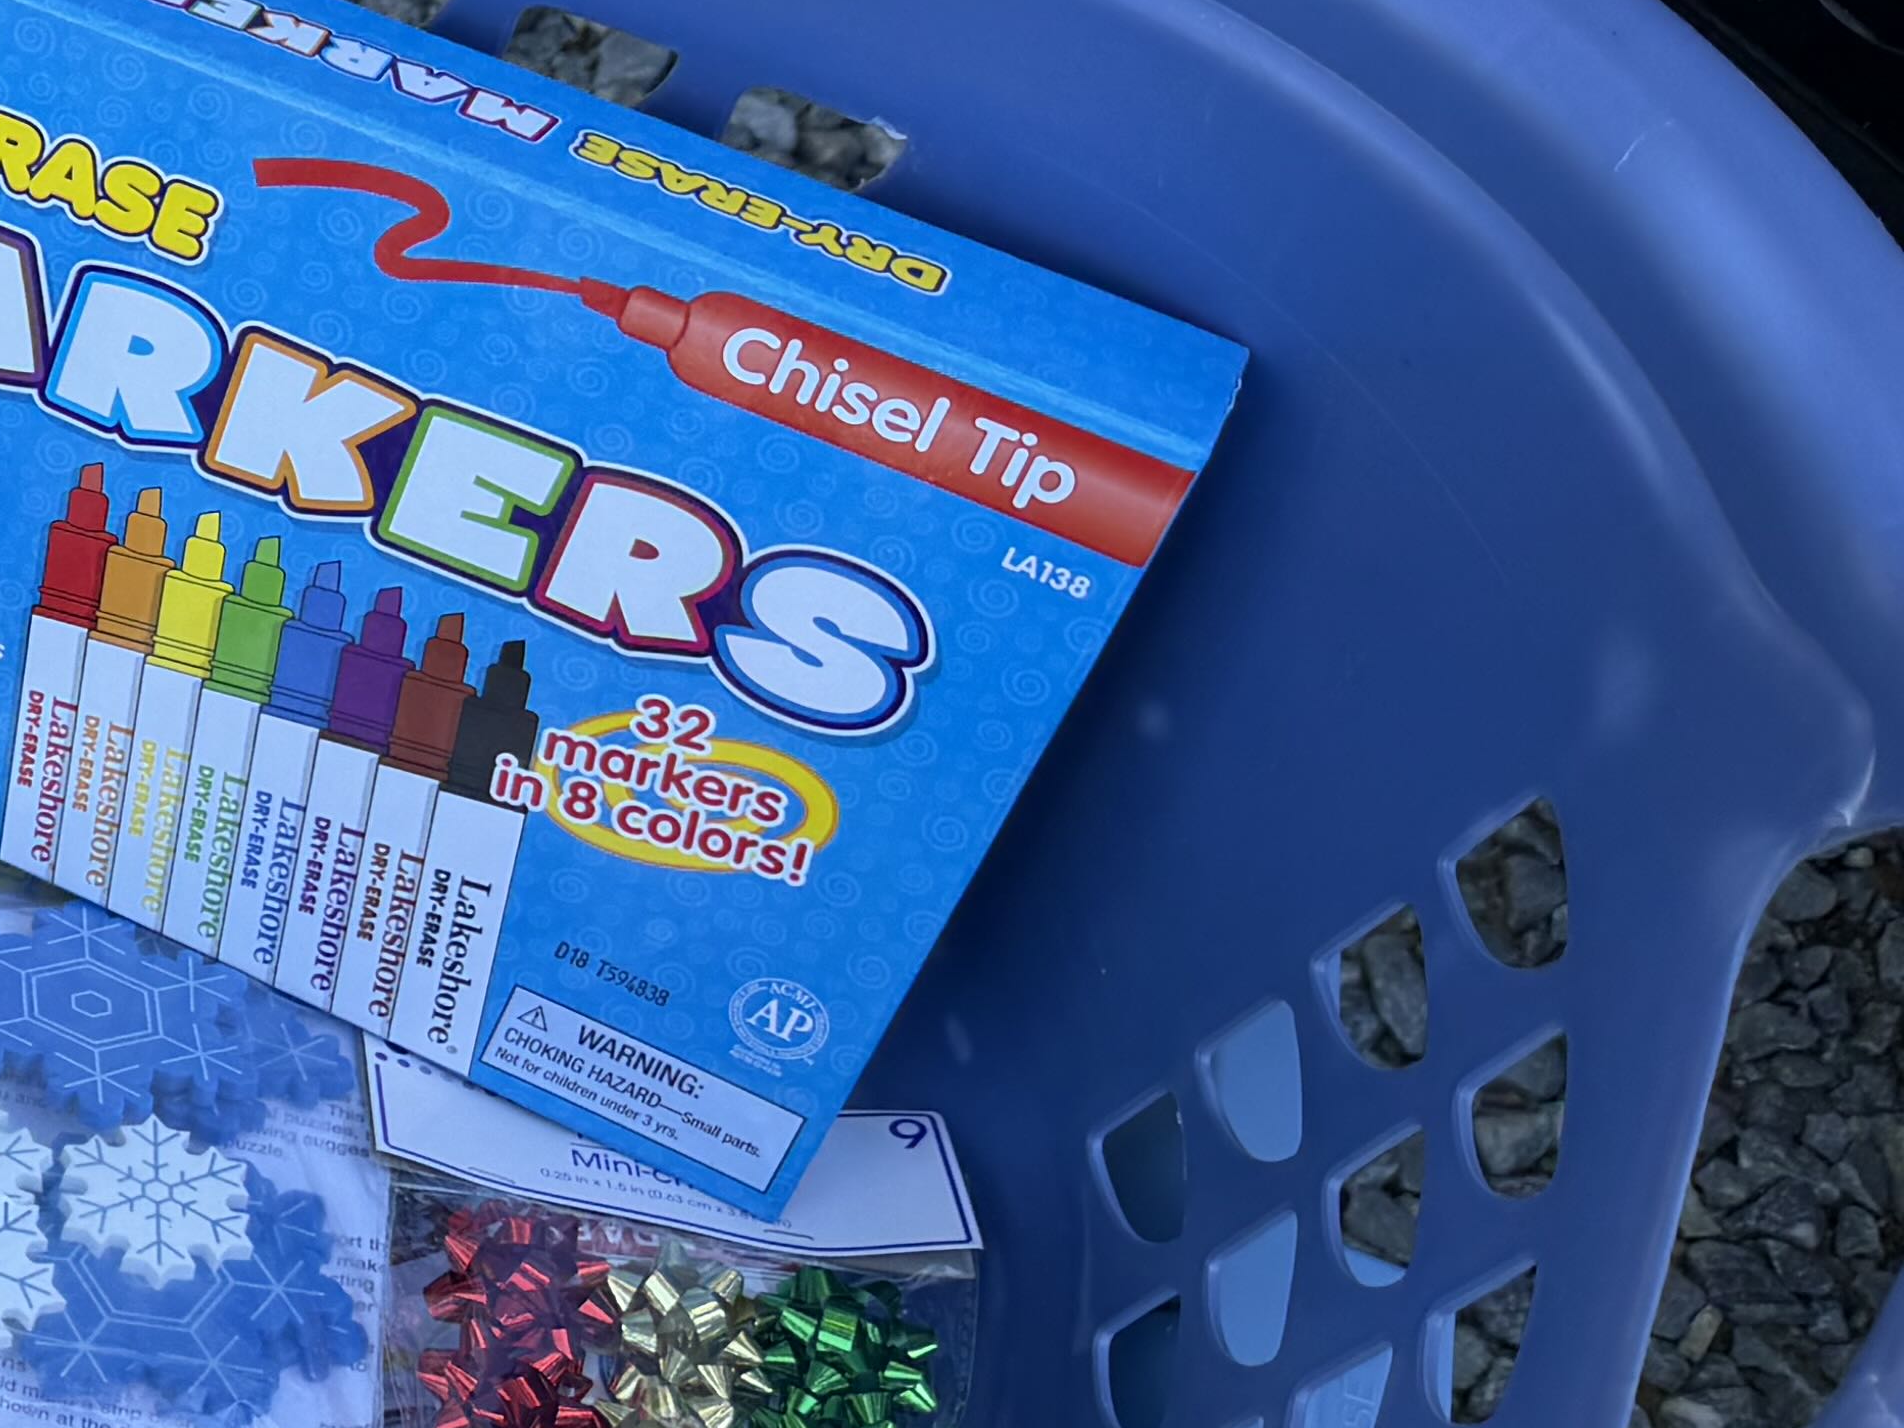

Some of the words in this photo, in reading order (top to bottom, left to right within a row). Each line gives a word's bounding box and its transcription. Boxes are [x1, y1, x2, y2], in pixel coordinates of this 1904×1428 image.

[575, 131, 948, 294] DRY-ERASE
[723, 328, 950, 452] Chisel
[968, 417, 1075, 509] Tip
[1001, 546, 1092, 600] LA138
[17, 690, 45, 788] DRY-ERASE
[72, 715, 100, 812] DRY-ERASE
[636, 698, 712, 752] 32
[31, 696, 79, 863] Lakeshore
[85, 722, 135, 888] Lakeshore
[185, 765, 215, 863] DRY-ERASE
[494, 758, 543, 807] in
[563, 780, 599, 820] 8
[617, 804, 809, 882] colors!
[542, 731, 784, 822] markers
[142, 747, 191, 913] Lakeshore
[198, 772, 248, 939] Lakeshore
[241, 790, 273, 889] DRY-ERASE
[298, 816, 331, 915] DRY-ERASE
[253, 797, 307, 965] Lakeshore
[311, 822, 366, 991] Lakeshore
[357, 843, 390, 942] DRY-ERASE
[416, 869, 451, 968] DRY-ERASE
[368, 848, 425, 1018] Lakeshore
[427, 875, 492, 1046] Lakeshore
[554, 941, 590, 969] D18
[595, 960, 671, 1008] T594838
[578, 1024, 705, 1100] WARNING:
[745, 998, 816, 1043] AP
[495, 1047, 519, 1067] Not
[522, 1057, 541, 1074] for
[543, 1067, 598, 1101] children
[600, 1091, 640, 1121] under
[642, 1111, 653, 1126] 3
[654, 1119, 680, 1142] yrs.
[504, 1027, 585, 1075] CHOKING
[723, 1130, 761, 1158] parts.
[889, 1118, 928, 1150] 9
[56, 1409, 76, 1428] at
